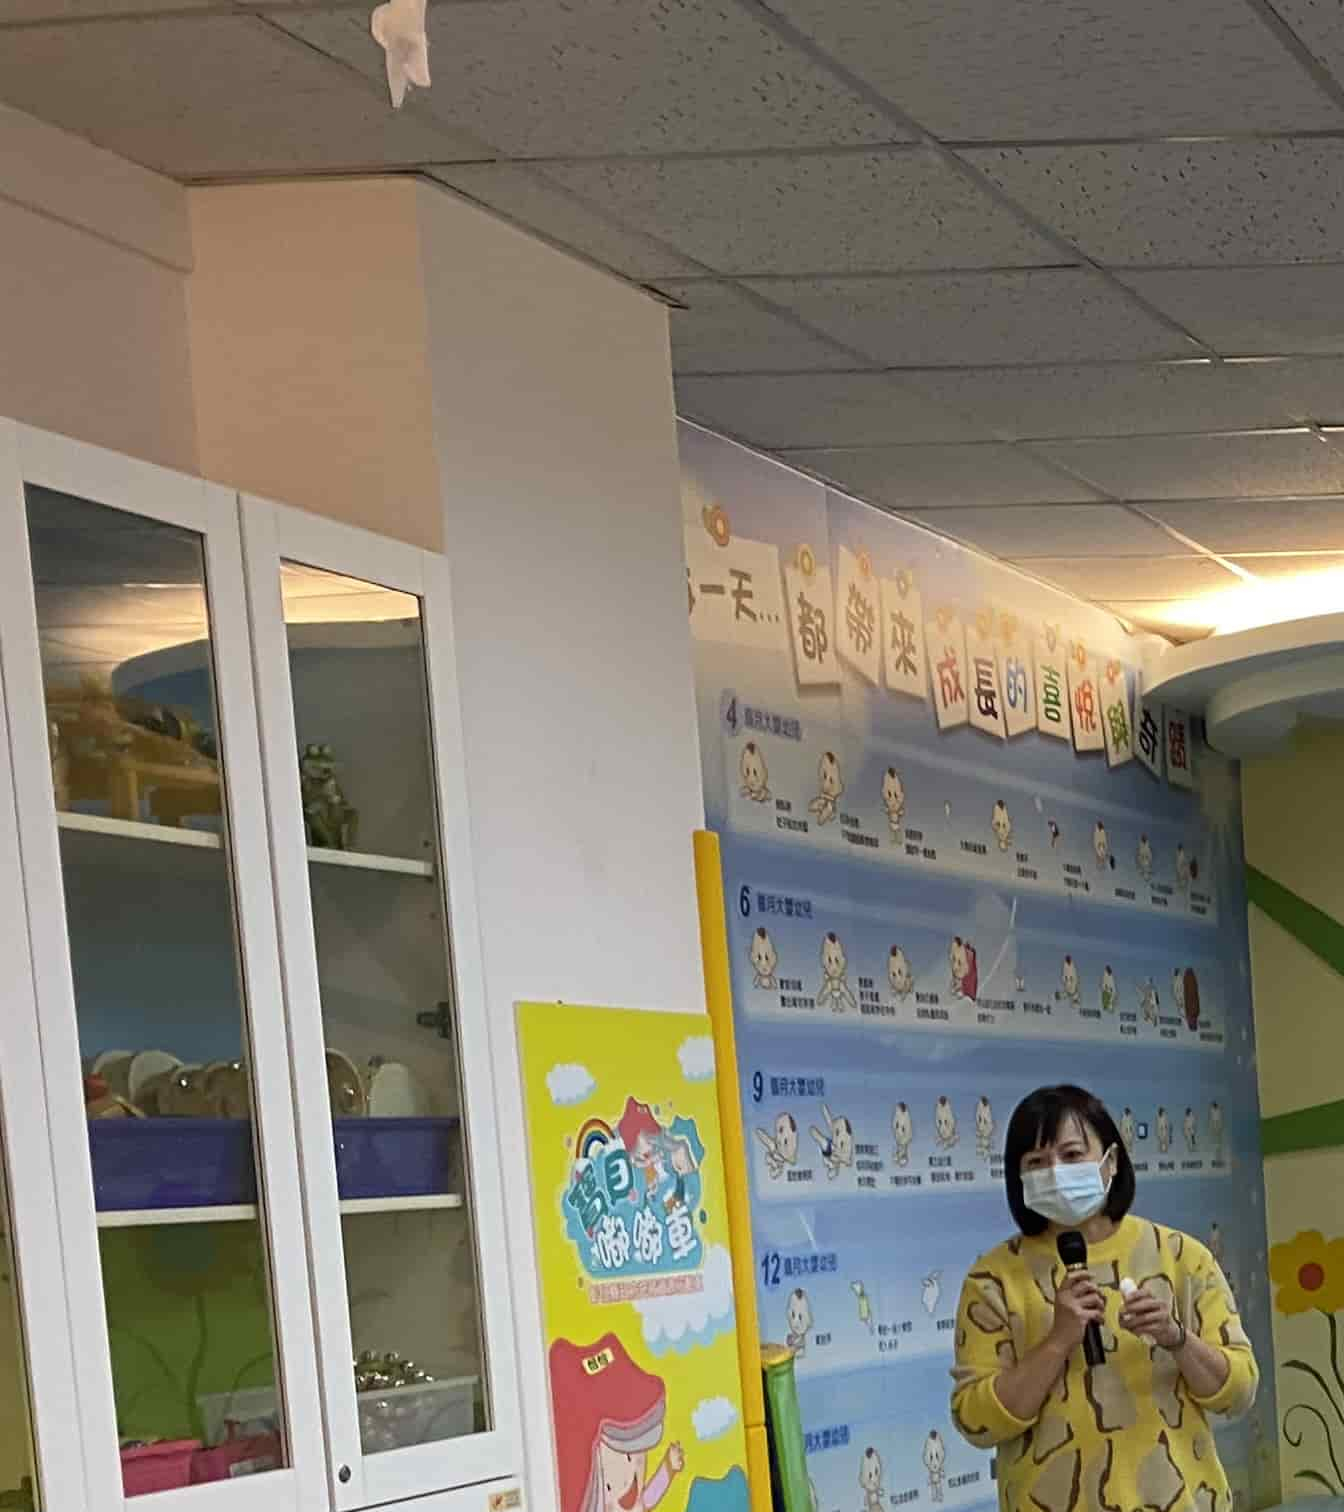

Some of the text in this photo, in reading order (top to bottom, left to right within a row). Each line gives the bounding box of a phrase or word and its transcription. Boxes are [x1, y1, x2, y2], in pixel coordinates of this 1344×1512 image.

[726, 698, 737, 729] 4
[740, 885, 750, 917] 6
[753, 1071, 763, 1103] 9
[761, 1252, 780, 1286] 12
